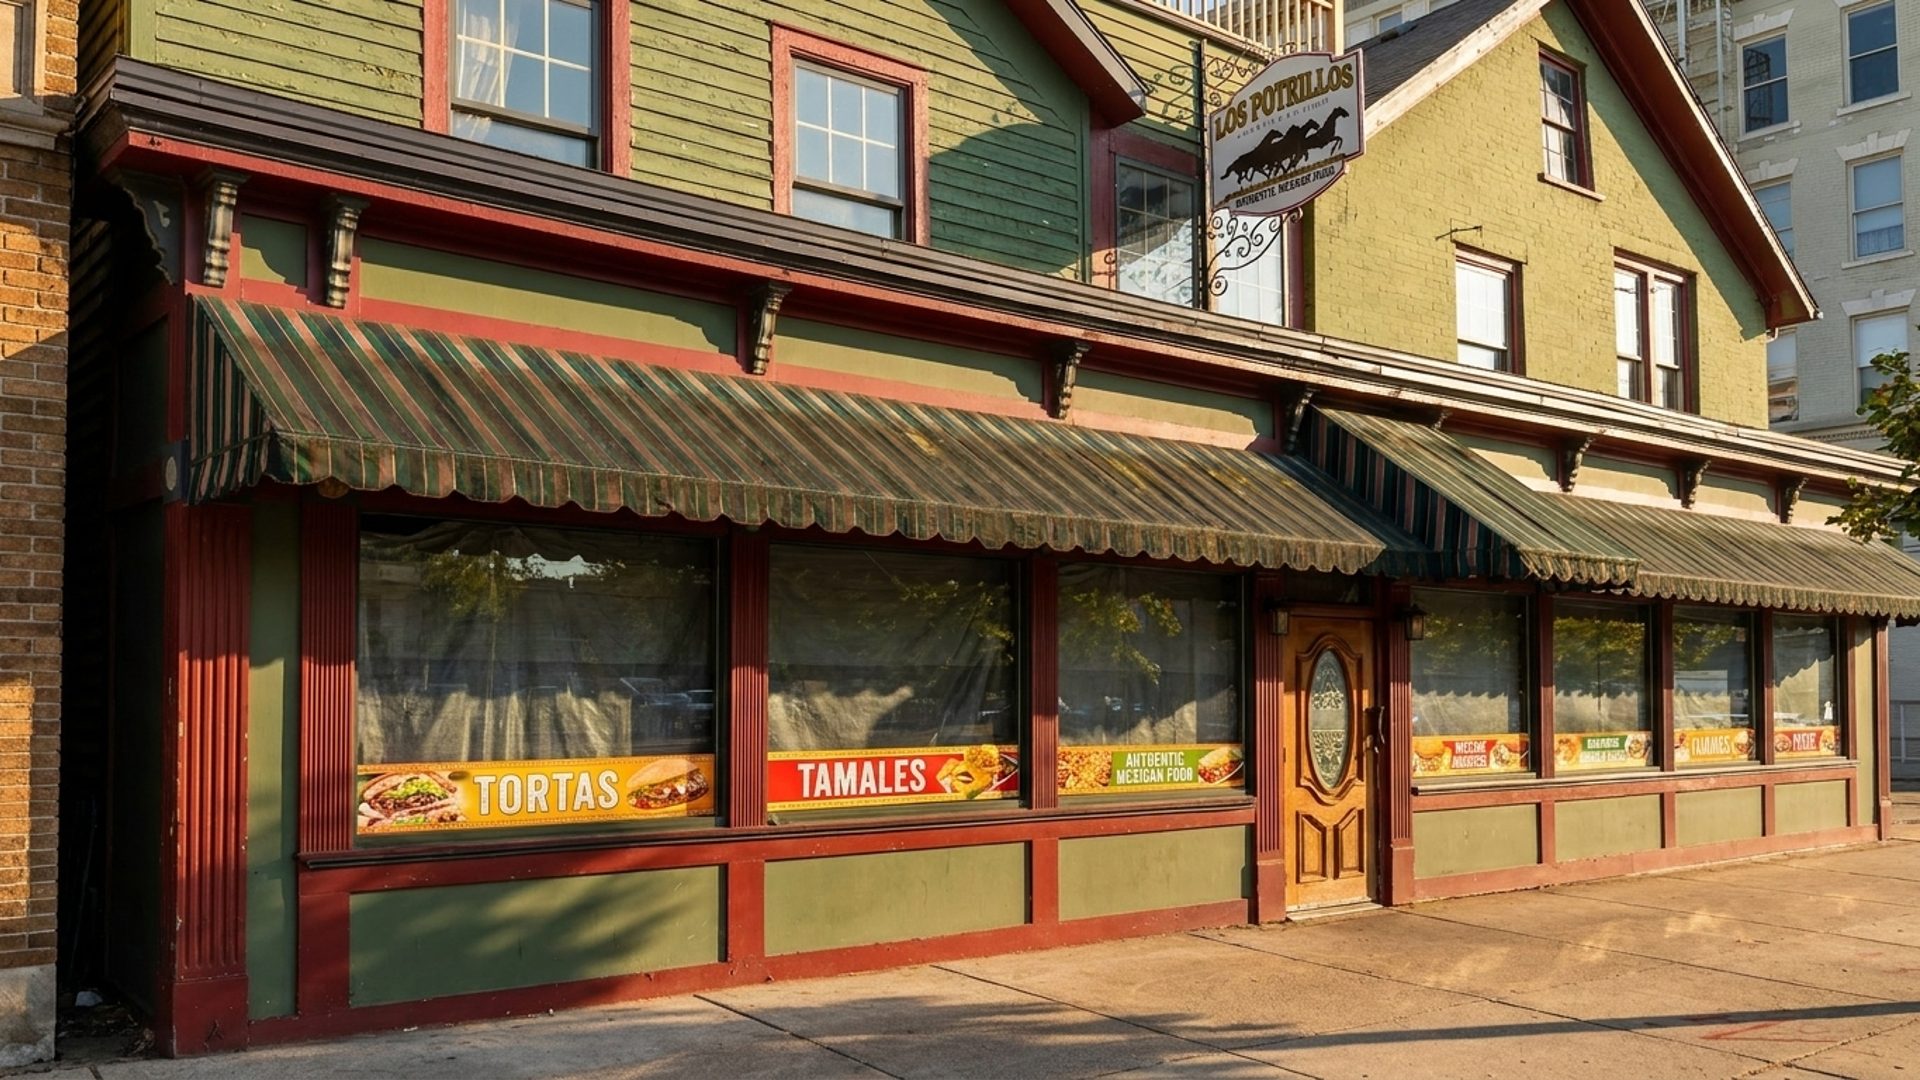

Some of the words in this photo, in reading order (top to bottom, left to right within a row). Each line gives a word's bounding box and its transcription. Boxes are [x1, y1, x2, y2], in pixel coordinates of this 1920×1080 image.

[1214, 100, 1248, 141] LOS
[1249, 62, 1354, 123] POTRILLOS
[473, 769, 619, 816] TORTAS
[797, 758, 926, 798] TAMALES
